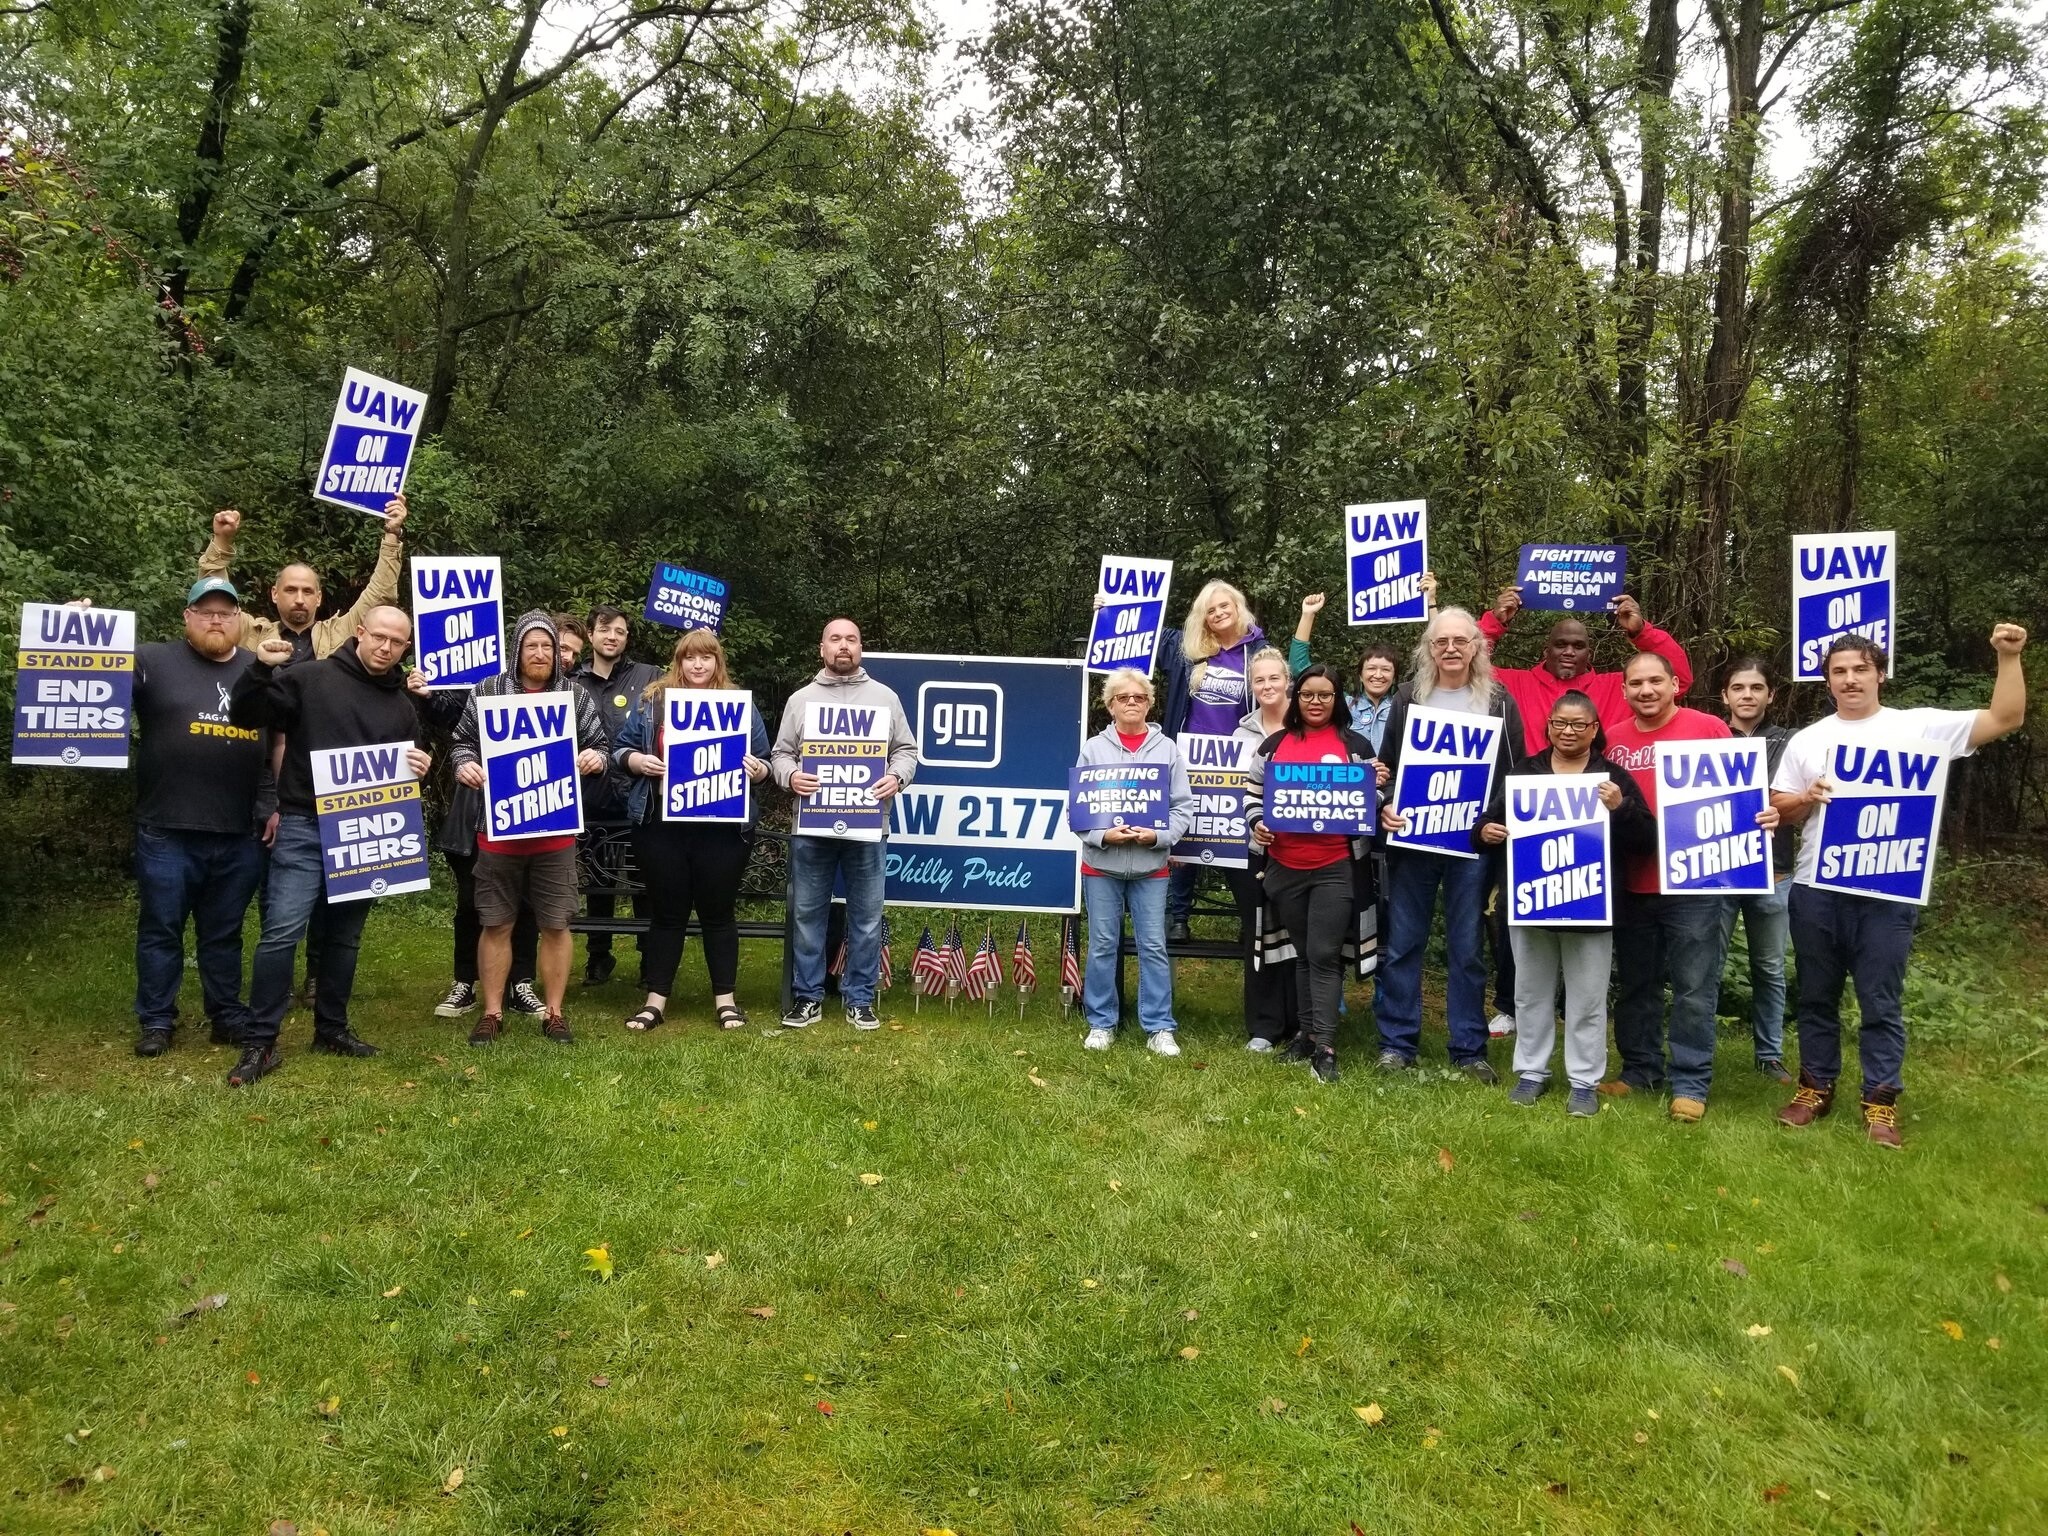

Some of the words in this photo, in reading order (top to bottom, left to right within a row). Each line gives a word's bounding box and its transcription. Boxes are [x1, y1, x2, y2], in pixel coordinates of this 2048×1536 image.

[346, 380, 419, 430] UAW
[355, 434, 388, 463] ON
[324, 464, 401, 493] STRIKE
[1351, 511, 1420, 543] UAW
[1374, 549, 1400, 582] ON
[1530, 549, 1616, 563] FIGHTING
[1799, 545, 1887, 581] UAW
[417, 569, 494, 600] UAW
[663, 567, 725, 597] UNITED
[686, 588, 699, 596] FOR
[1104, 567, 1165, 598] UAW
[1524, 570, 1616, 583] AMERICAN
[1538, 583, 1600, 596] DREAM
[657, 586, 721, 615] STRONG
[1354, 571, 1421, 617] STRIKE
[654, 600, 719, 627] CONTRACT
[1115, 607, 1141, 635] ON
[1828, 591, 1861, 630] ON
[41, 609, 118, 647] UAW
[445, 610, 474, 644] ON
[424, 634, 497, 682] STRIKE
[1091, 631, 1154, 665] STRIKE
[1802, 619, 1886, 672] STE
[26, 654, 94, 668] STAND
[101, 656, 127, 669] UP
[37, 679, 112, 703] END
[21, 706, 125, 730] TIERS
[484, 704, 567, 742] UAW
[671, 700, 745, 731] UAW
[819, 707, 876, 737] UAW
[933, 703, 988, 747] gm
[190, 722, 258, 741] STRONG
[1411, 718, 1494, 760] UAW
[693, 742, 722, 776] ON
[808, 744, 857, 754] STAND
[862, 745, 881, 755] UP
[1188, 738, 1243, 768] UAW
[329, 748, 399, 786] UAW
[516, 750, 548, 789] ON
[816, 765, 871, 784] END
[1079, 768, 1159, 783] FIGHTING
[1187, 774, 1224, 785] TAND
[1230, 775, 1248, 785] UP
[1274, 765, 1365, 783] UNITED
[1663, 751, 1758, 789] UAW
[1834, 744, 1940, 791] UAW
[323, 791, 384, 811] STAND
[390, 786, 414, 799] UP
[671, 768, 743, 813] STRIKE
[809, 786, 879, 807] TIERS
[1076, 789, 1162, 804] AMERICAN
[1119, 780, 1138, 788] THE
[1274, 789, 1365, 806] STRONG
[1427, 769, 1461, 802] ON
[494, 775, 574, 831] STRIKE
[958, 795, 1064, 840] 2177
[1089, 801, 1148, 814] DREAM
[1272, 806, 1366, 820] CONTRACT
[1397, 800, 1480, 837] STRIKE
[1513, 787, 1600, 822] UAW
[338, 811, 405, 842] END
[1188, 815, 1246, 836] IERS
[1695, 800, 1732, 840] ON
[1857, 802, 1900, 839] ON
[327, 833, 421, 869] TIERS
[1541, 832, 1574, 873] ON
[1669, 829, 1764, 885] STRIKE
[1821, 837, 1925, 879] STRIKE
[340, 868, 357, 877] MORE
[359, 866, 371, 874] 2ND
[372, 863, 392, 871] CLASS
[393, 857, 424, 868] WORKERS
[885, 853, 953, 893] Philly
[963, 857, 1032, 889] Pride
[1516, 861, 1602, 916] STRIKE
